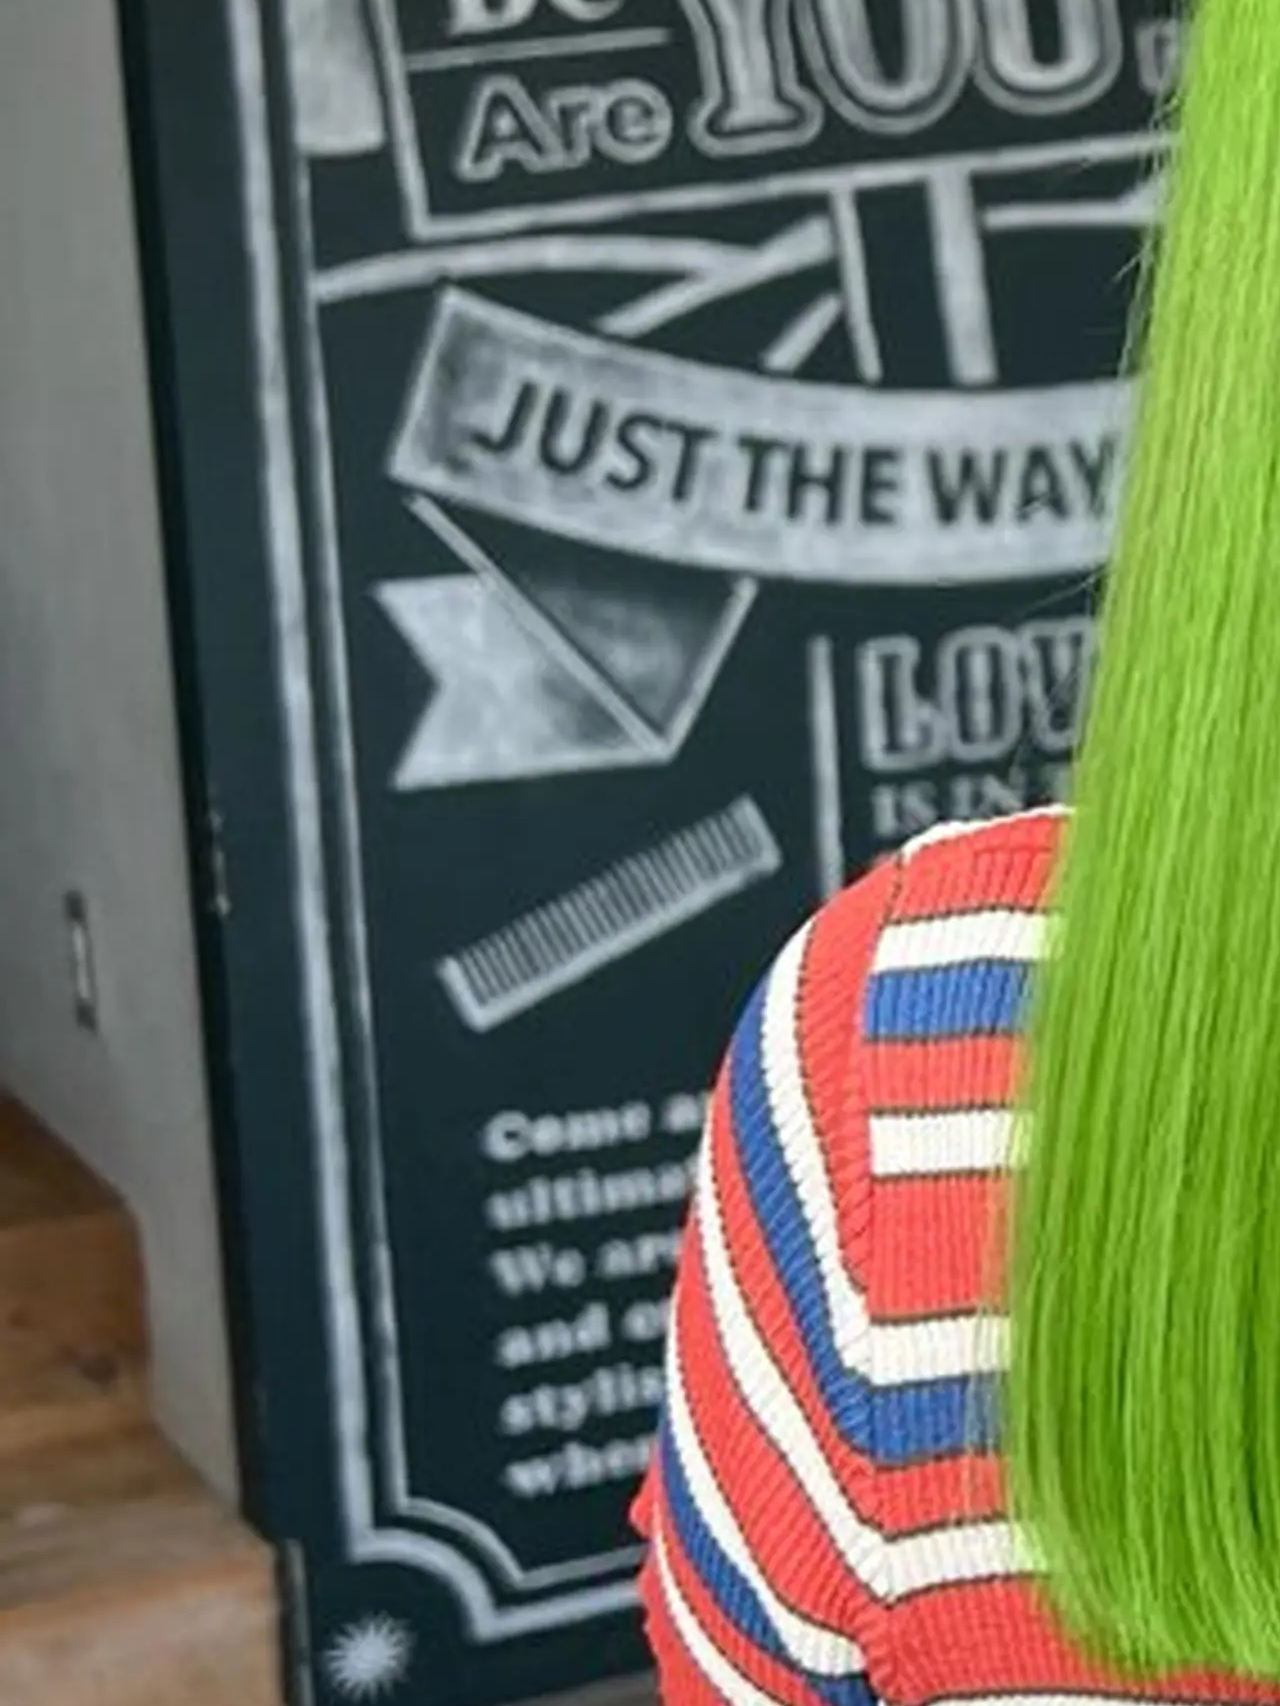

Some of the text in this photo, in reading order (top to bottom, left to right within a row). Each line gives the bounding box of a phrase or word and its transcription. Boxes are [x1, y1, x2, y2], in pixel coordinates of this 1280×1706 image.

[455, 76, 674, 181] Are
[470, 381, 1120, 527] JUST THE WAY
[484, 1101, 652, 1161] Come
[486, 1155, 698, 1229] ultima
[490, 1239, 588, 1295] We
[496, 1299, 612, 1367] and
